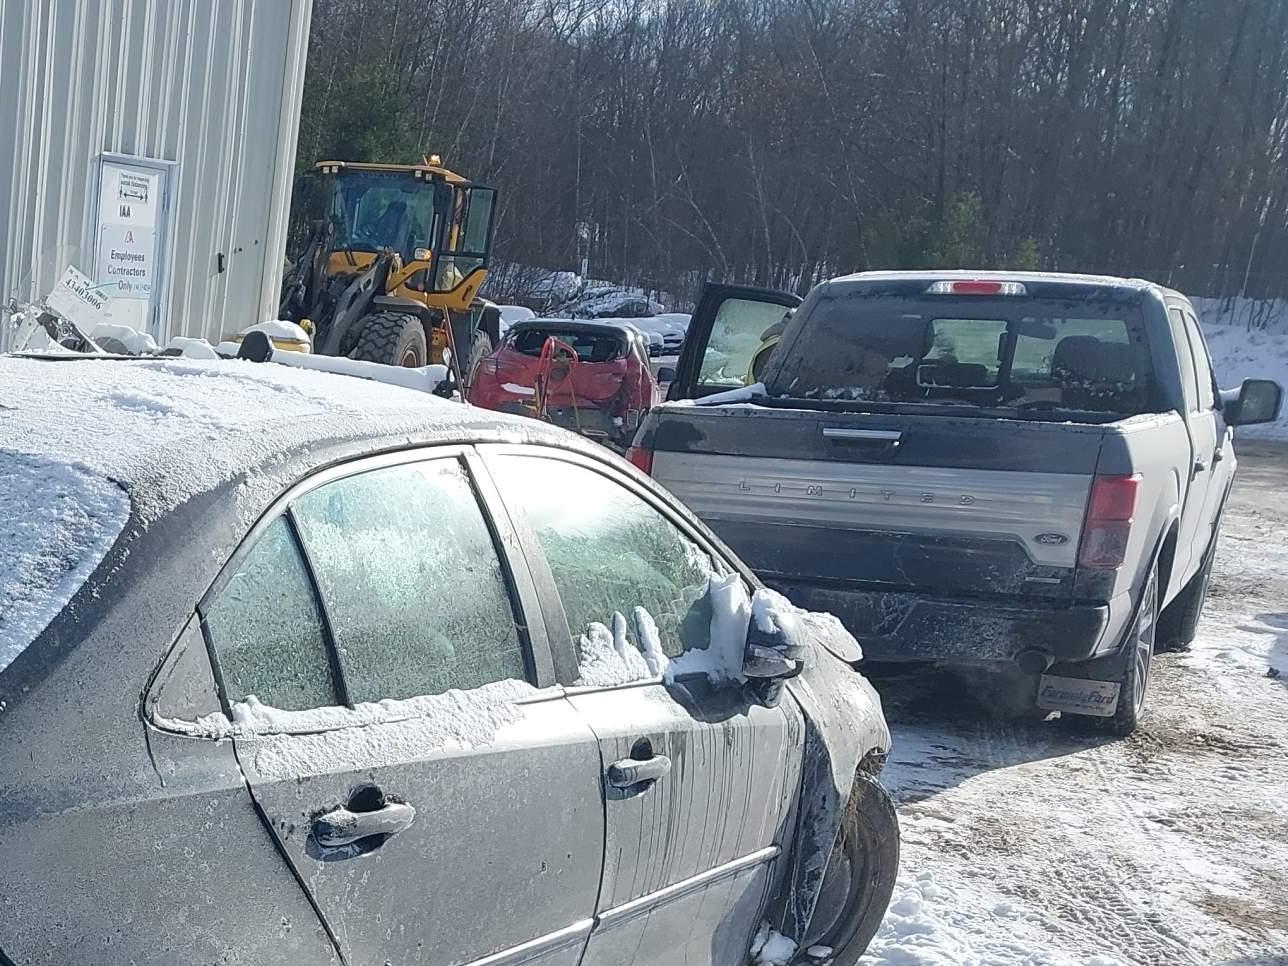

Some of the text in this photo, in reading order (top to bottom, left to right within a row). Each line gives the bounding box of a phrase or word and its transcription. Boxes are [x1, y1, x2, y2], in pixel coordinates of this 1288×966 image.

[119, 204, 131, 218] IAA
[110, 249, 145, 263] Employees
[107, 264, 146, 277] Contractors
[118, 279, 133, 292] Only
[65, 279, 103, 310] 43403006
[738, 480, 976, 506] LIMITED
